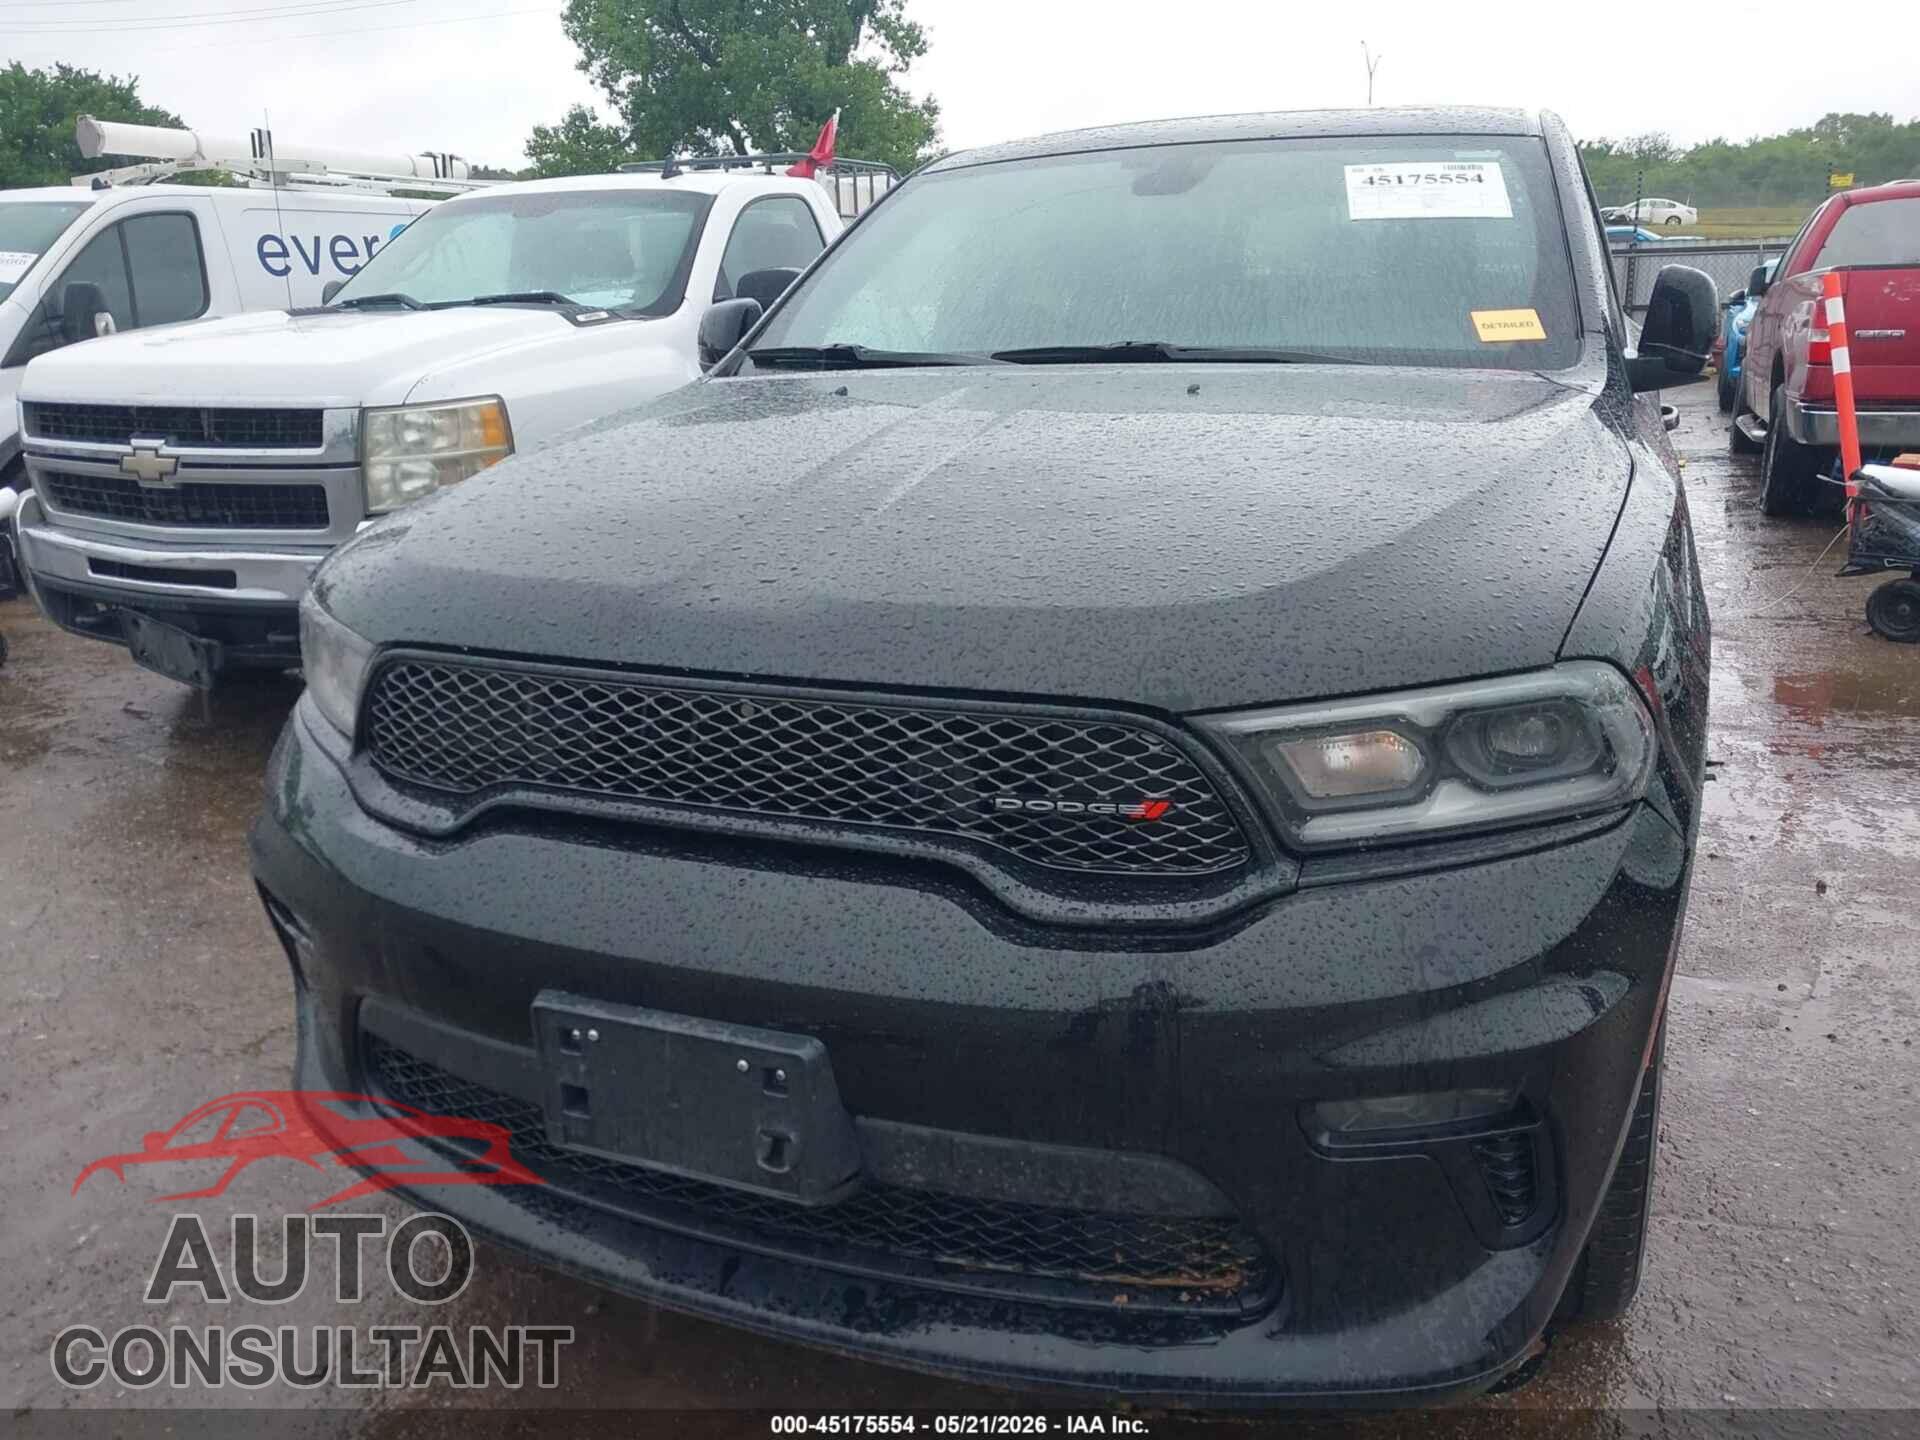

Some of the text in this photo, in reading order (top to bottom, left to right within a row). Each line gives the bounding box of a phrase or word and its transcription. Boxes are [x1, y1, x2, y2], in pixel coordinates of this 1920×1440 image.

[1361, 173, 1485, 186] 45175554
[257, 223, 407, 277] ever
[995, 797, 1147, 816] DODGE
